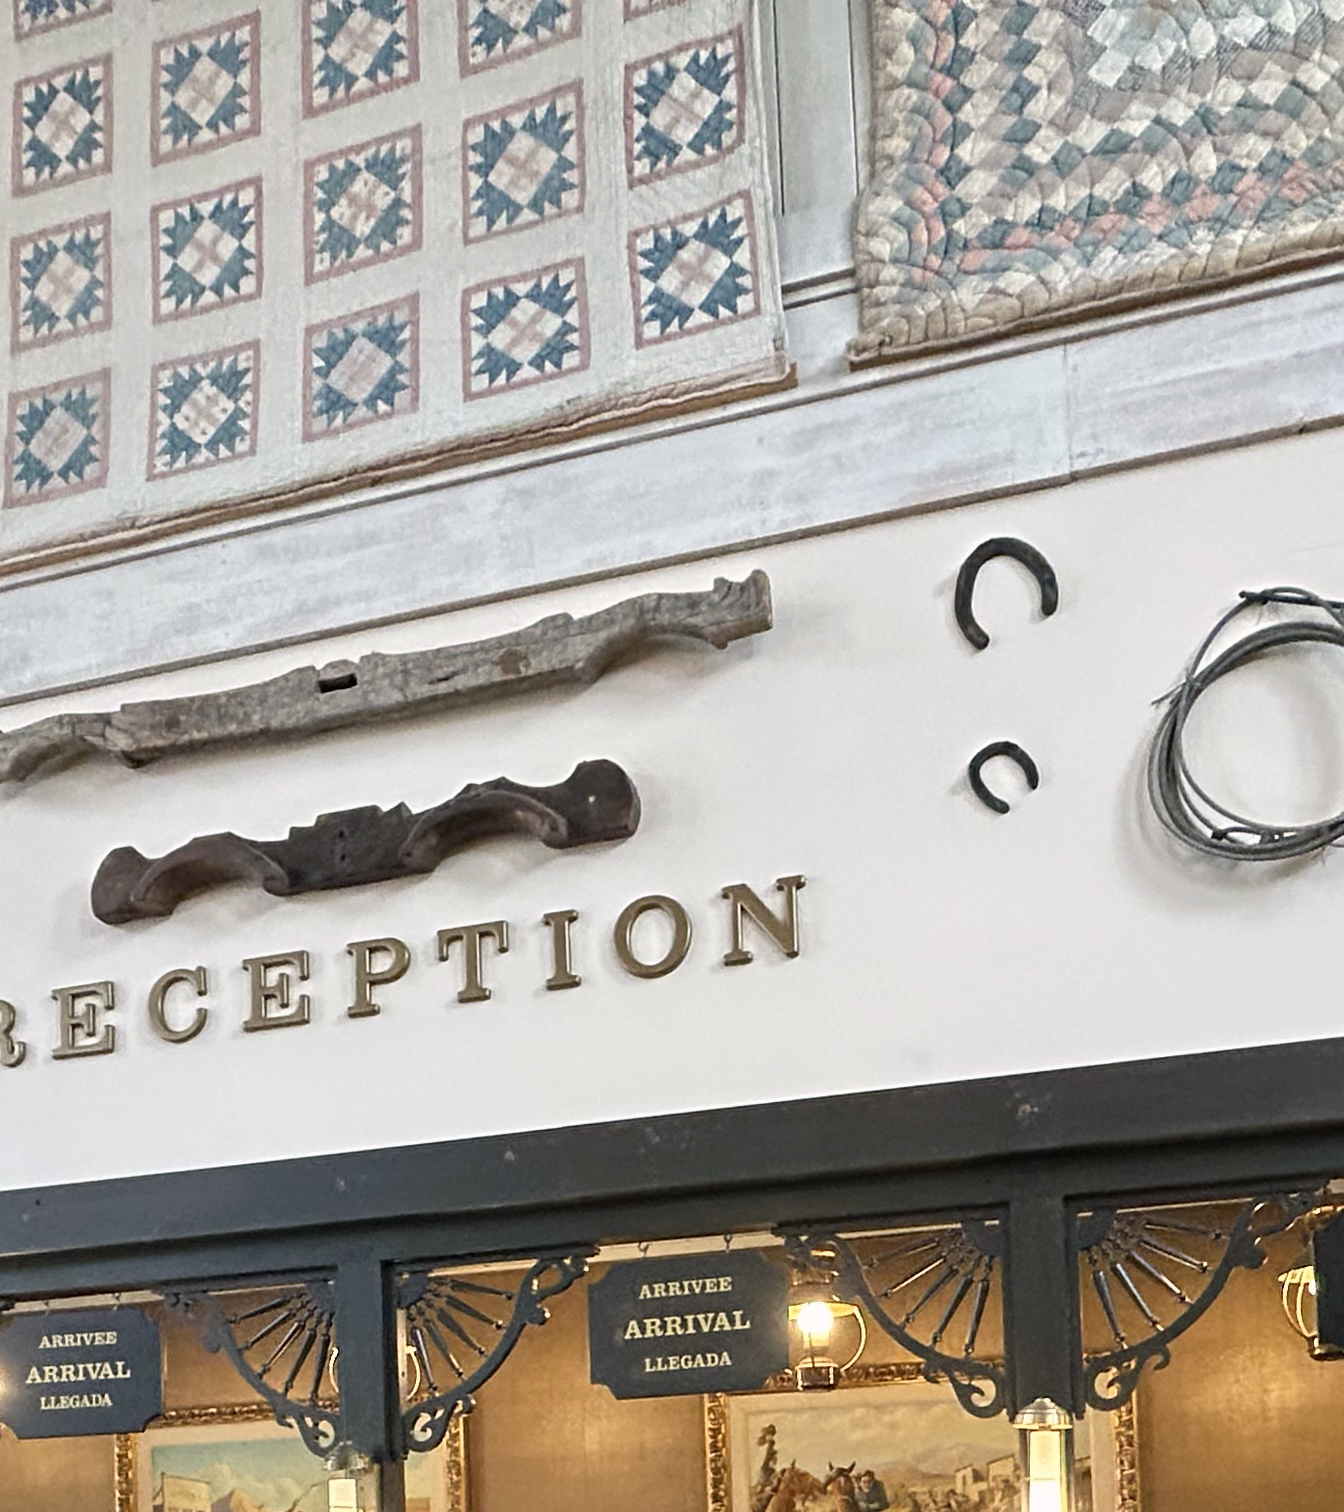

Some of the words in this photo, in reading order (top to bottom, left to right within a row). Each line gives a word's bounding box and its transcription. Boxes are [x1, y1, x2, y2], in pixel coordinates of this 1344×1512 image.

[639, 1277, 732, 1300] ARRIVEE
[624, 1310, 751, 1340] ARRIVAL
[38, 1331, 117, 1349] ARRIVEE
[25, 1361, 131, 1384] ARRIVAL
[645, 1352, 732, 1373] LLEGADA
[40, 1393, 113, 1410] LLEGADA
